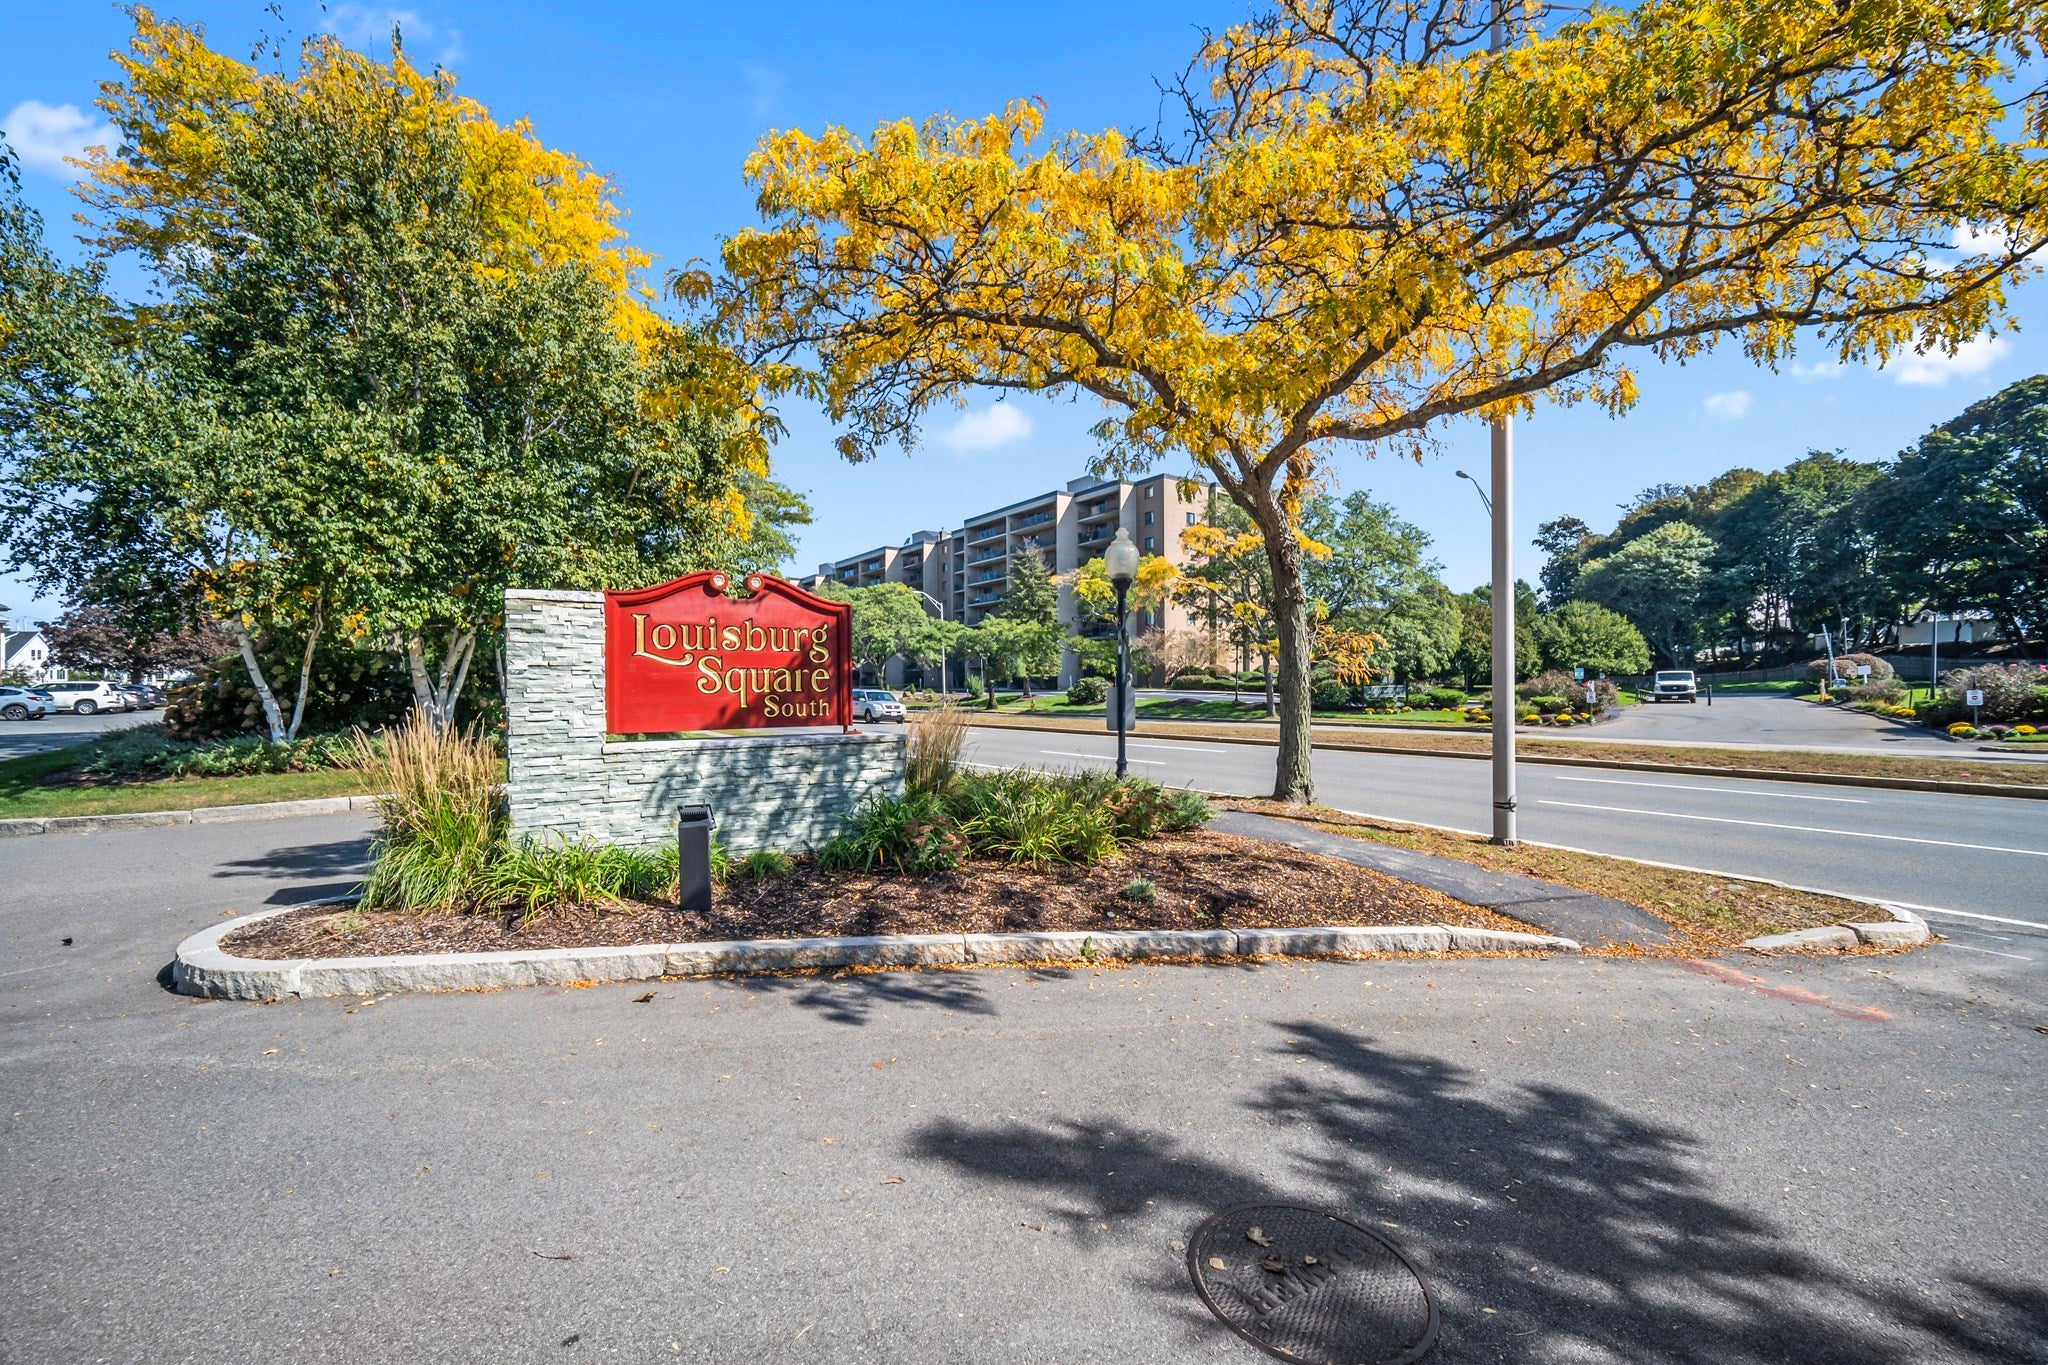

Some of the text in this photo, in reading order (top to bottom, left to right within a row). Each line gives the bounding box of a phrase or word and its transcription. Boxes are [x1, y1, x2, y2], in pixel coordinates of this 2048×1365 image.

[631, 613, 831, 666] Louisburg
[696, 655, 831, 708] Square
[763, 694, 831, 718] South
